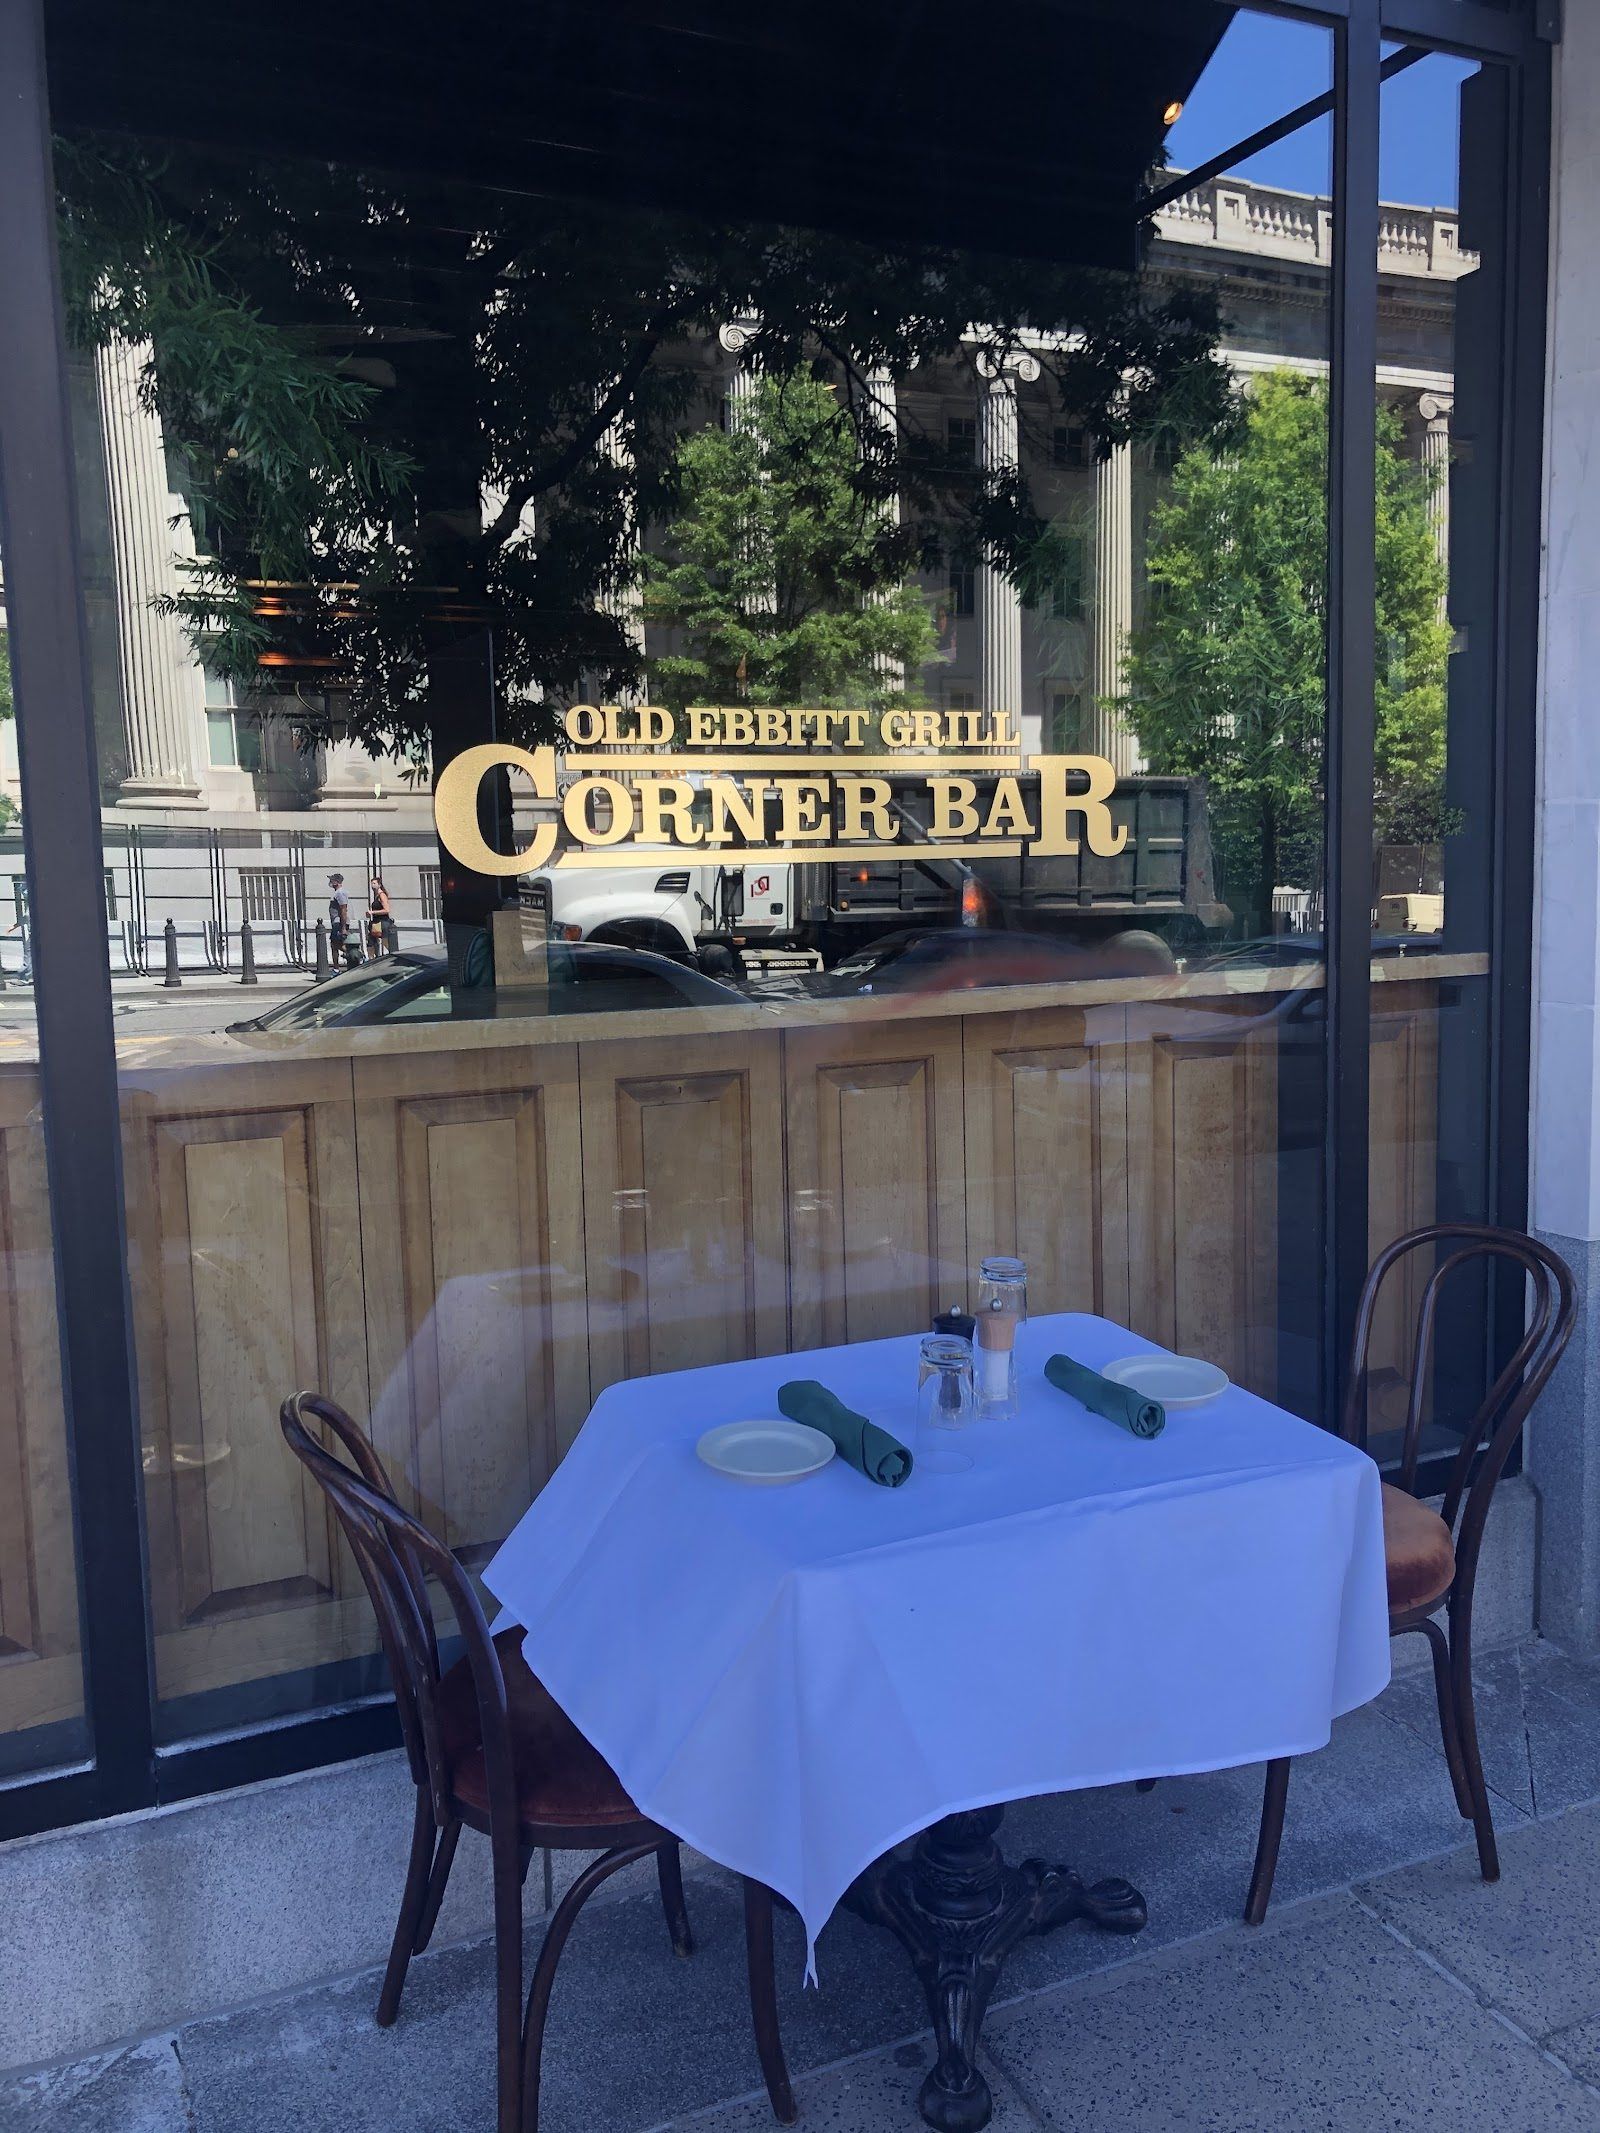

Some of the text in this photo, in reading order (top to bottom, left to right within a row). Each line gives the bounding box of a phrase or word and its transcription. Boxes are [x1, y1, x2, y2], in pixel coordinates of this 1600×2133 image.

[565, 705, 1022, 748] OLD EBBITT GRILL
[434, 744, 1129, 876] CORNER BAR
